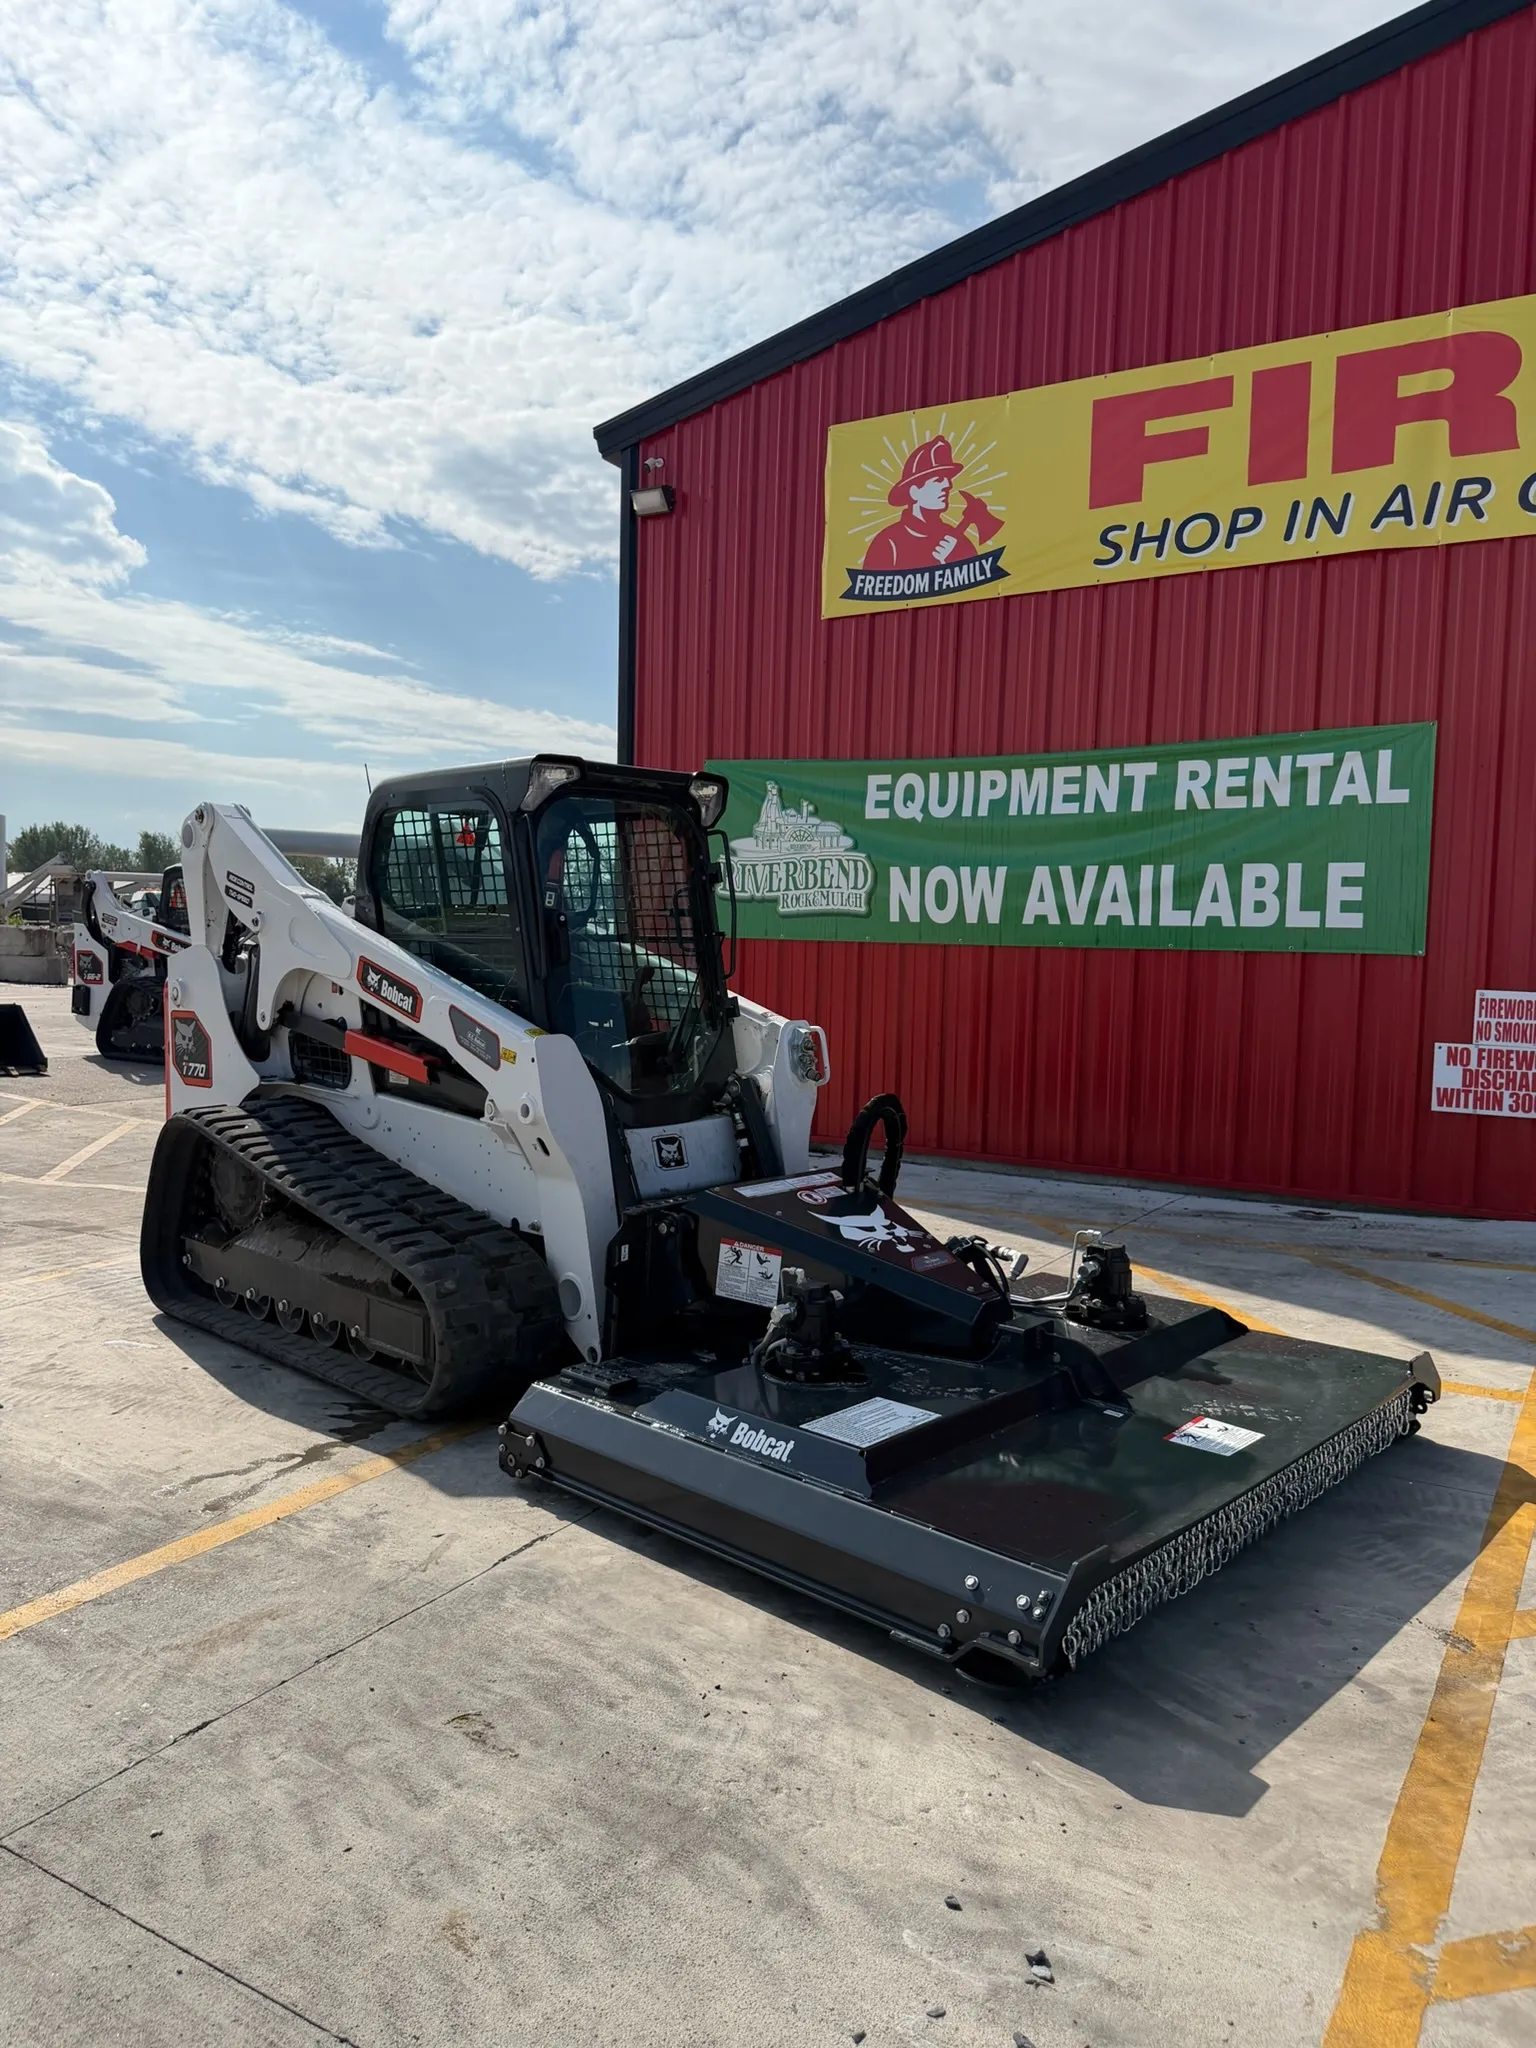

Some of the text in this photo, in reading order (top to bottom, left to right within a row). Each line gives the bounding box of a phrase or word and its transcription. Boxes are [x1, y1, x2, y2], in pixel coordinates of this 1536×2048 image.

[1088, 330, 1522, 509] FIR
[1093, 510, 1264, 568] SHOP
[1283, 492, 1353, 542] IN
[1370, 476, 1494, 531] AIR
[854, 556, 993, 596] FREEDOM FAMILY
[865, 749, 1410, 824] EQUIPMENT RENTAL
[719, 857, 869, 894] RIVERBEND
[889, 862, 1366, 929] NOW AVAILABLE
[381, 979, 413, 1013] Bobcat
[1478, 997, 1536, 1021] FIREWOR
[1476, 1020, 1492, 1041] NO
[1446, 1046, 1536, 1071] NO FIREW
[1436, 1087, 1536, 1114] WITHIN 30
[740, 1241, 765, 1252] DANGER
[729, 1421, 796, 1463] Bobcat
